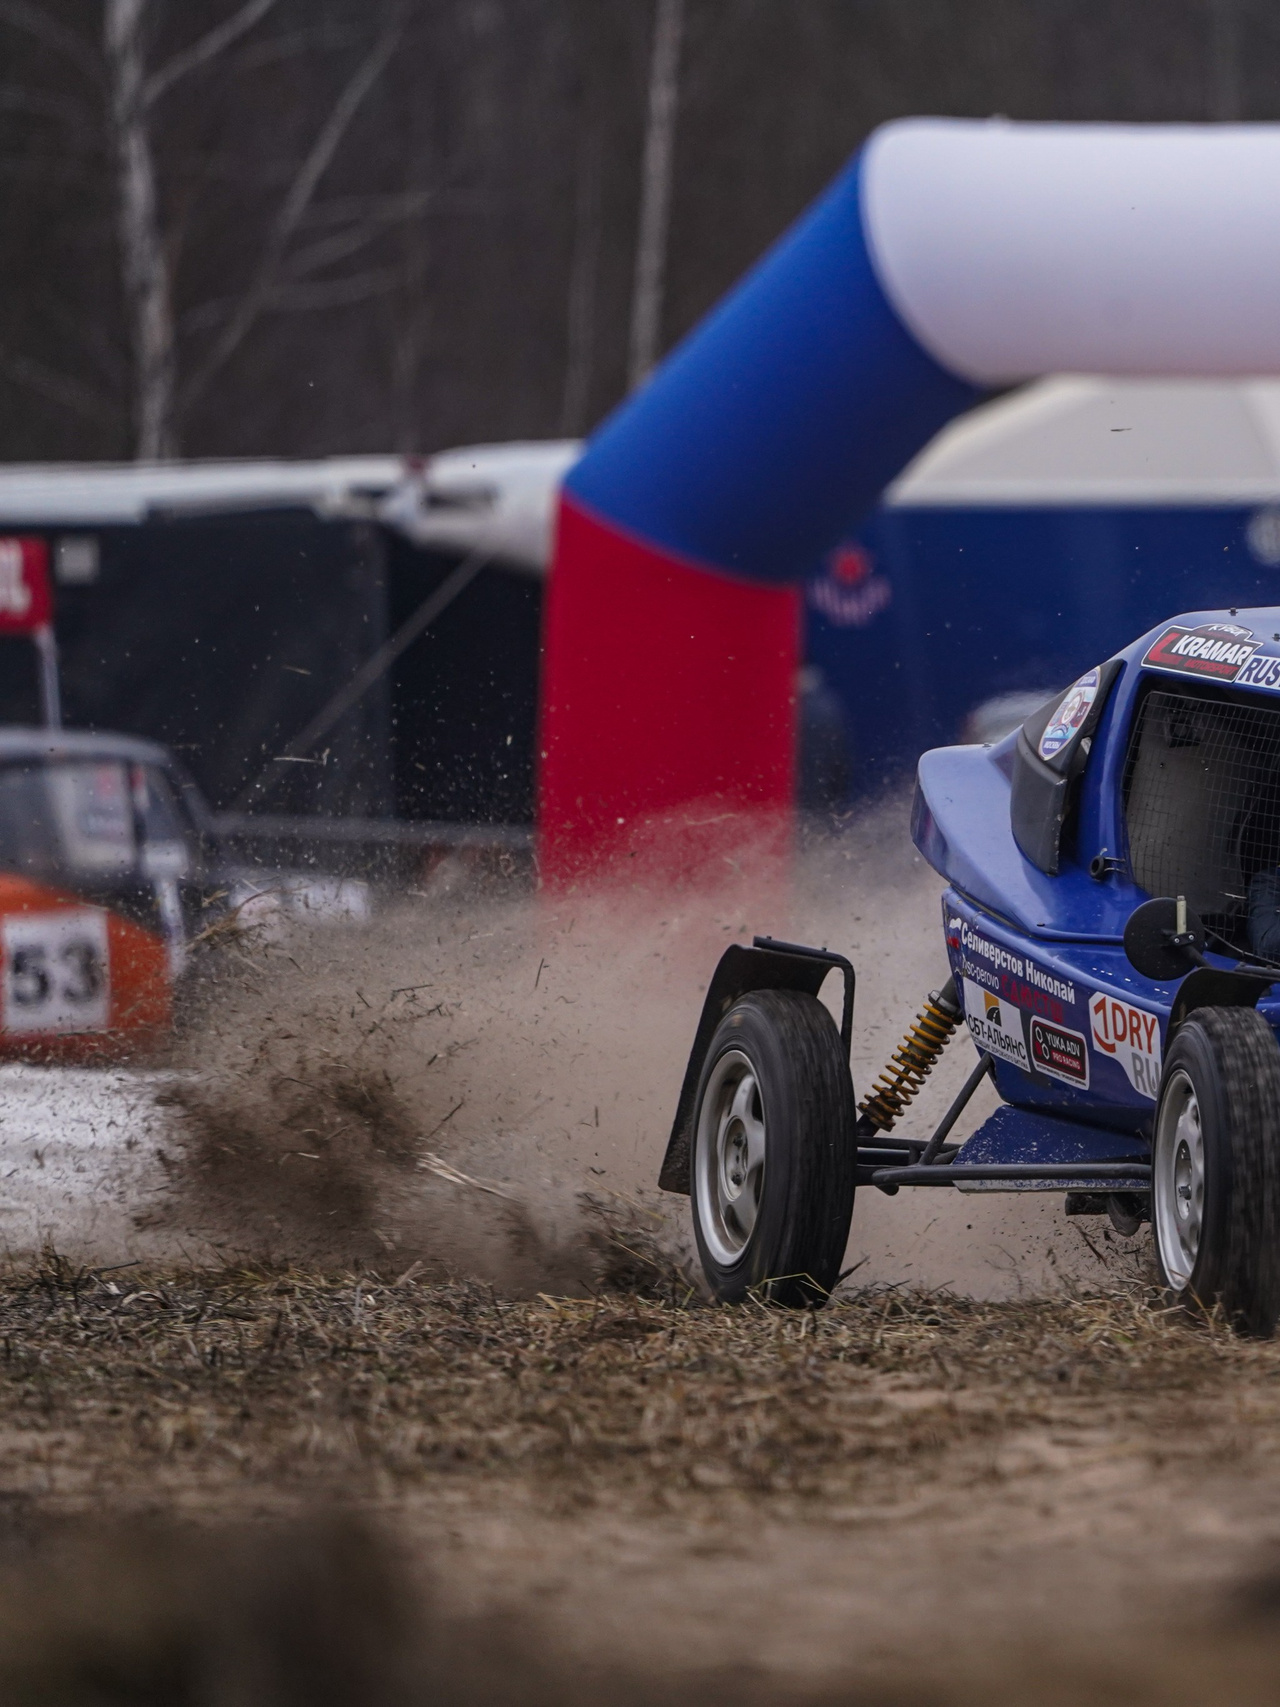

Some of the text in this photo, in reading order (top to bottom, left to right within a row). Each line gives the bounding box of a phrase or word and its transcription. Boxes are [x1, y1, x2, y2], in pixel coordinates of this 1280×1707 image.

[1171, 635, 1254, 666] KRAMAR
[1184, 659, 1239, 676] MOTORSPORT
[12, 940, 101, 1006] 53
[961, 922, 1076, 1005] Селиверстов Николай
[968, 1014, 1026, 1060] СБТ-АЛЬЯНС
[1093, 996, 1157, 1055] 1DRY
[1131, 1052, 1160, 1099] RU
